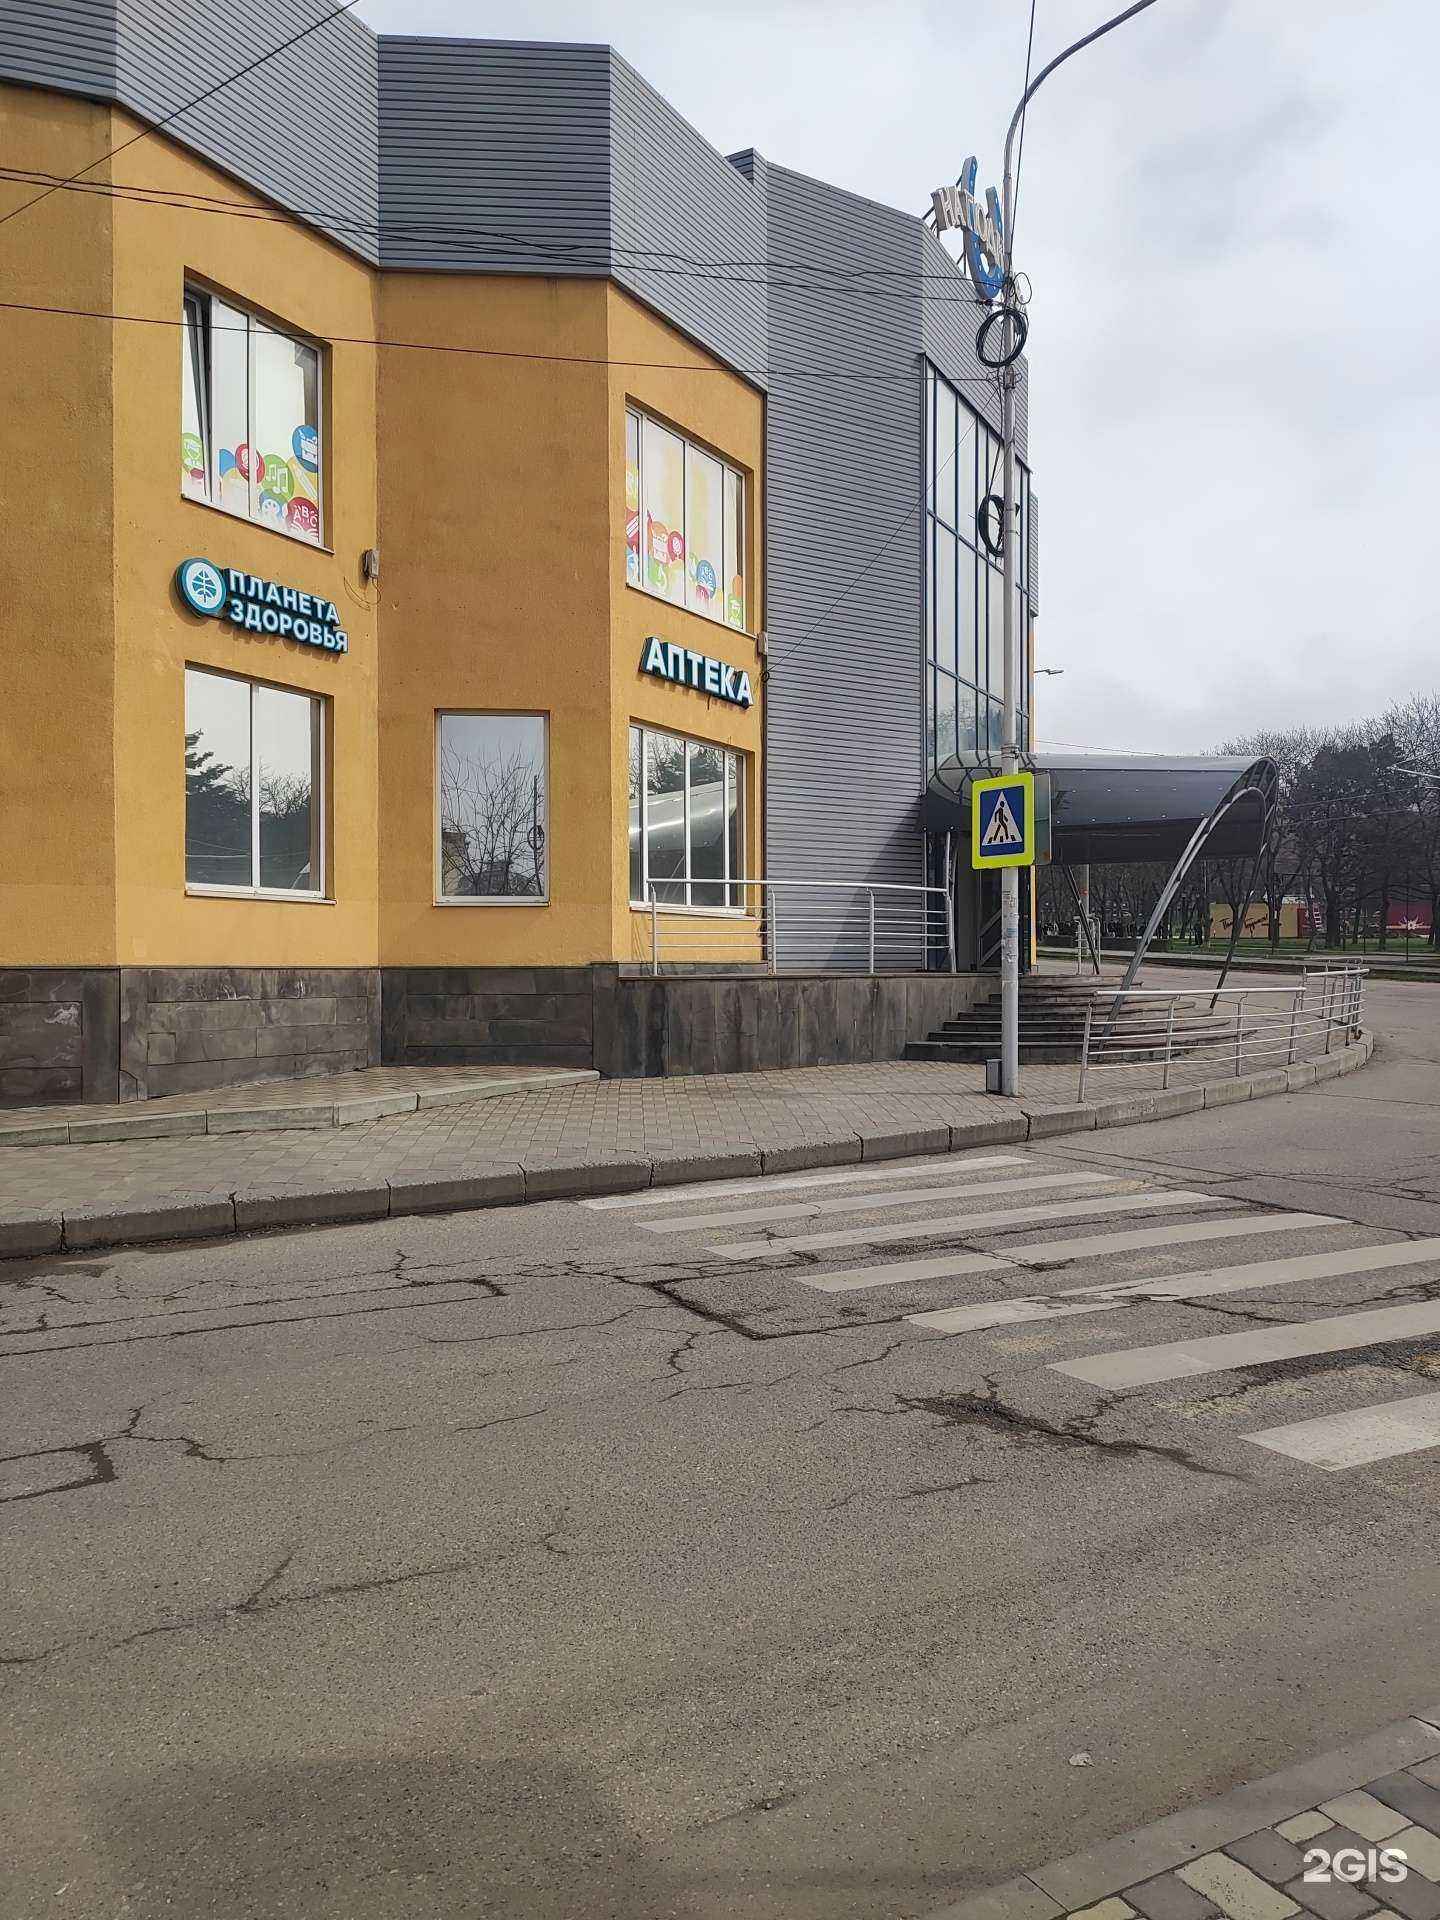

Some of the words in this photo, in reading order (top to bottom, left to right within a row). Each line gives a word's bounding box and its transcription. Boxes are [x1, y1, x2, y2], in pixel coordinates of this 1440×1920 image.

[228, 569, 341, 625] ПЛАНЕТА
[229, 599, 349, 653] ЗДОРОВЬЯ
[643, 637, 754, 706] АПТЕКА
